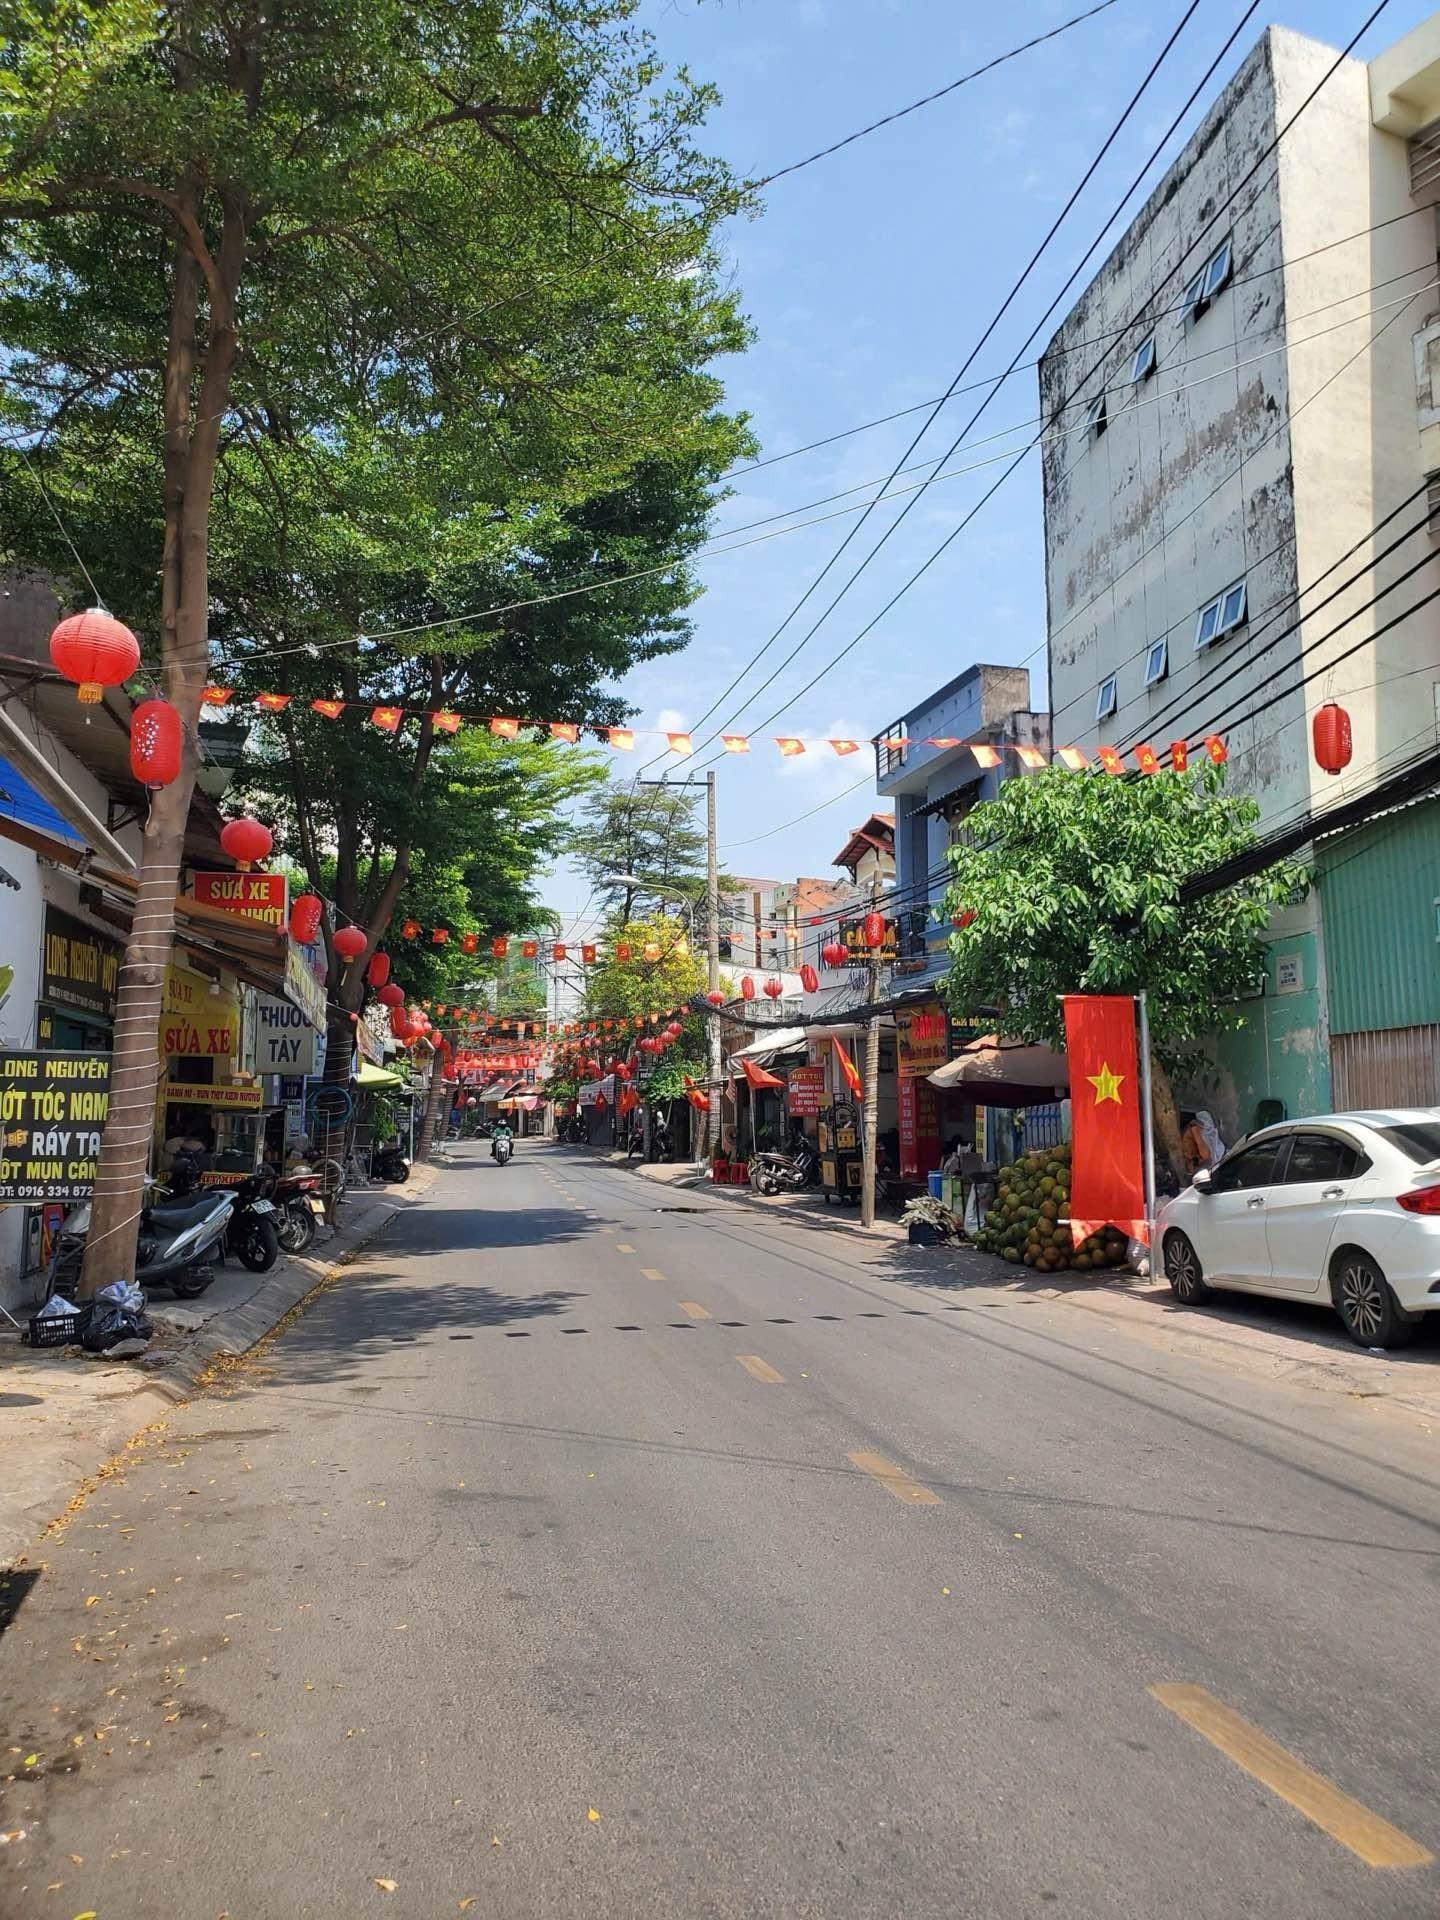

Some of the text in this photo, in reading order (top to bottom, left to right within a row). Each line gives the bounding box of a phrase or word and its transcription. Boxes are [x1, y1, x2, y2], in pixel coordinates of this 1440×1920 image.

[248, 882, 270, 900] XE
[46, 933, 68, 978] LONG
[164, 1017, 231, 1054] SỬA XE
[268, 1033, 302, 1063] TÂY
[45, 1057, 109, 1079] NGUYỄN
[0, 1082, 109, 1121] ỚT TÓC NAM
[32, 1124, 71, 1156] RÁY
[26, 1162, 63, 1184] MỤN
[18, 1185, 44, 1197] 0916
[48, 1185, 70, 1197] 334
[73, 1186, 94, 1197] 872
